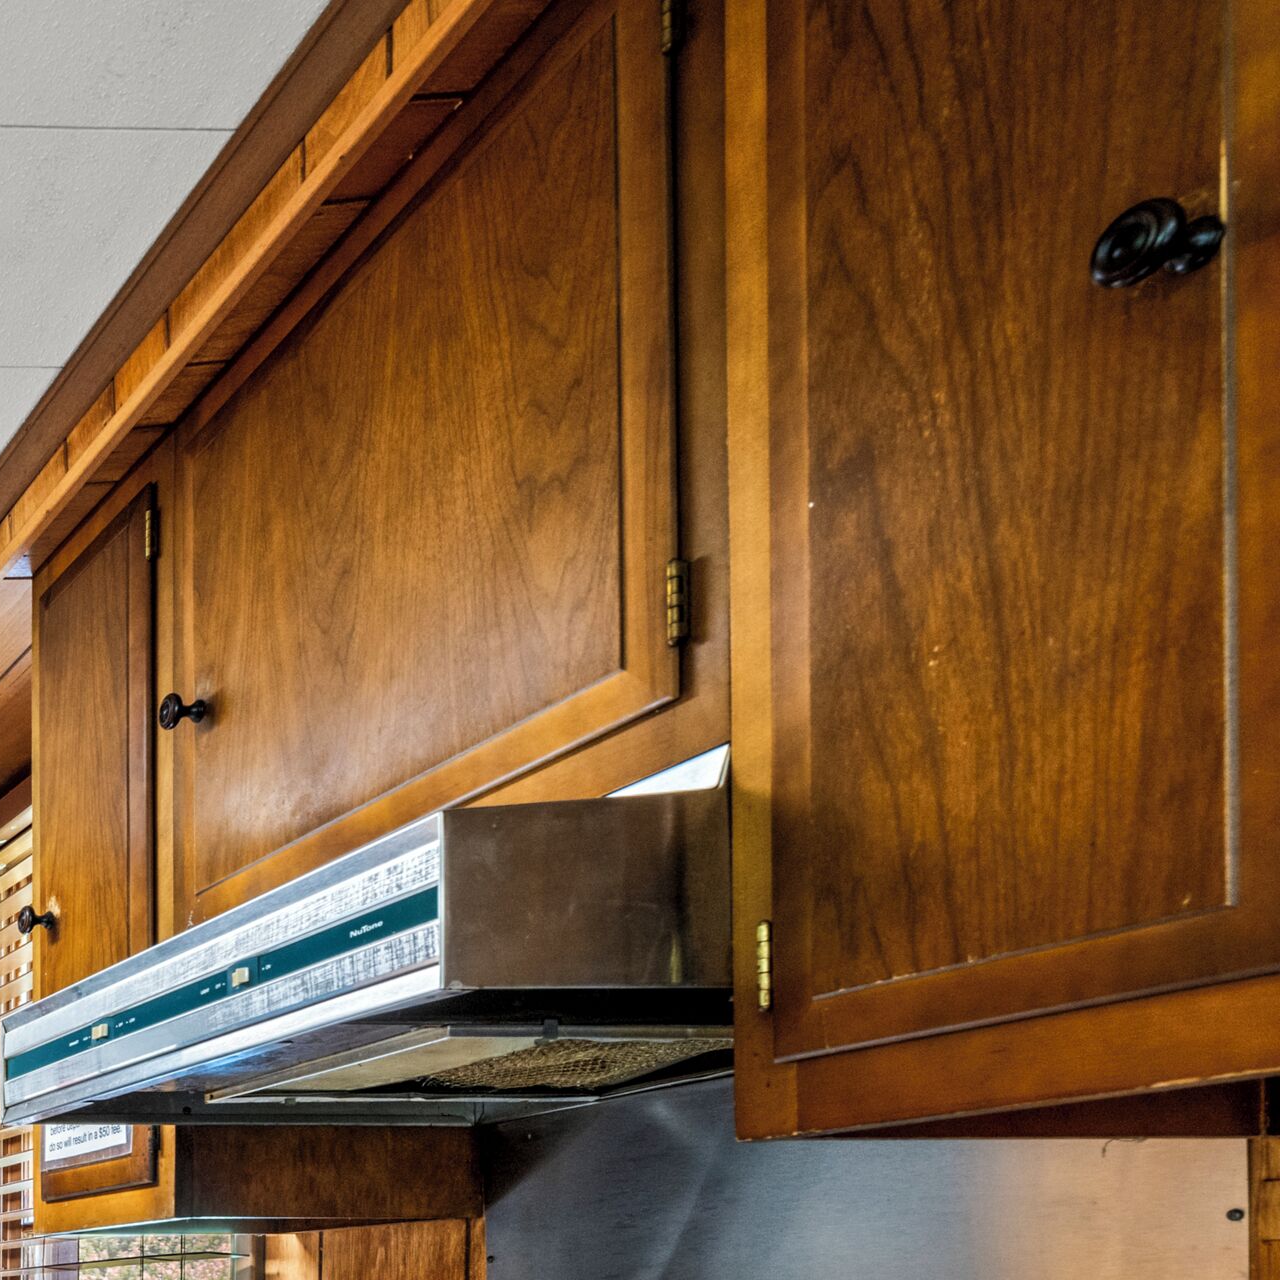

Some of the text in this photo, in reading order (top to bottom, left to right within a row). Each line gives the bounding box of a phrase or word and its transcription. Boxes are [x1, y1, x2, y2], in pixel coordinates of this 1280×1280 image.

[348, 919, 384, 940] NuTone
[49, 1142, 56, 1152] do
[56, 1141, 63, 1150] so
[72, 1132, 87, 1145] result
[88, 1130, 93, 1141] in
[94, 1131, 98, 1140] a
[98, 1125, 110, 1138] $50
